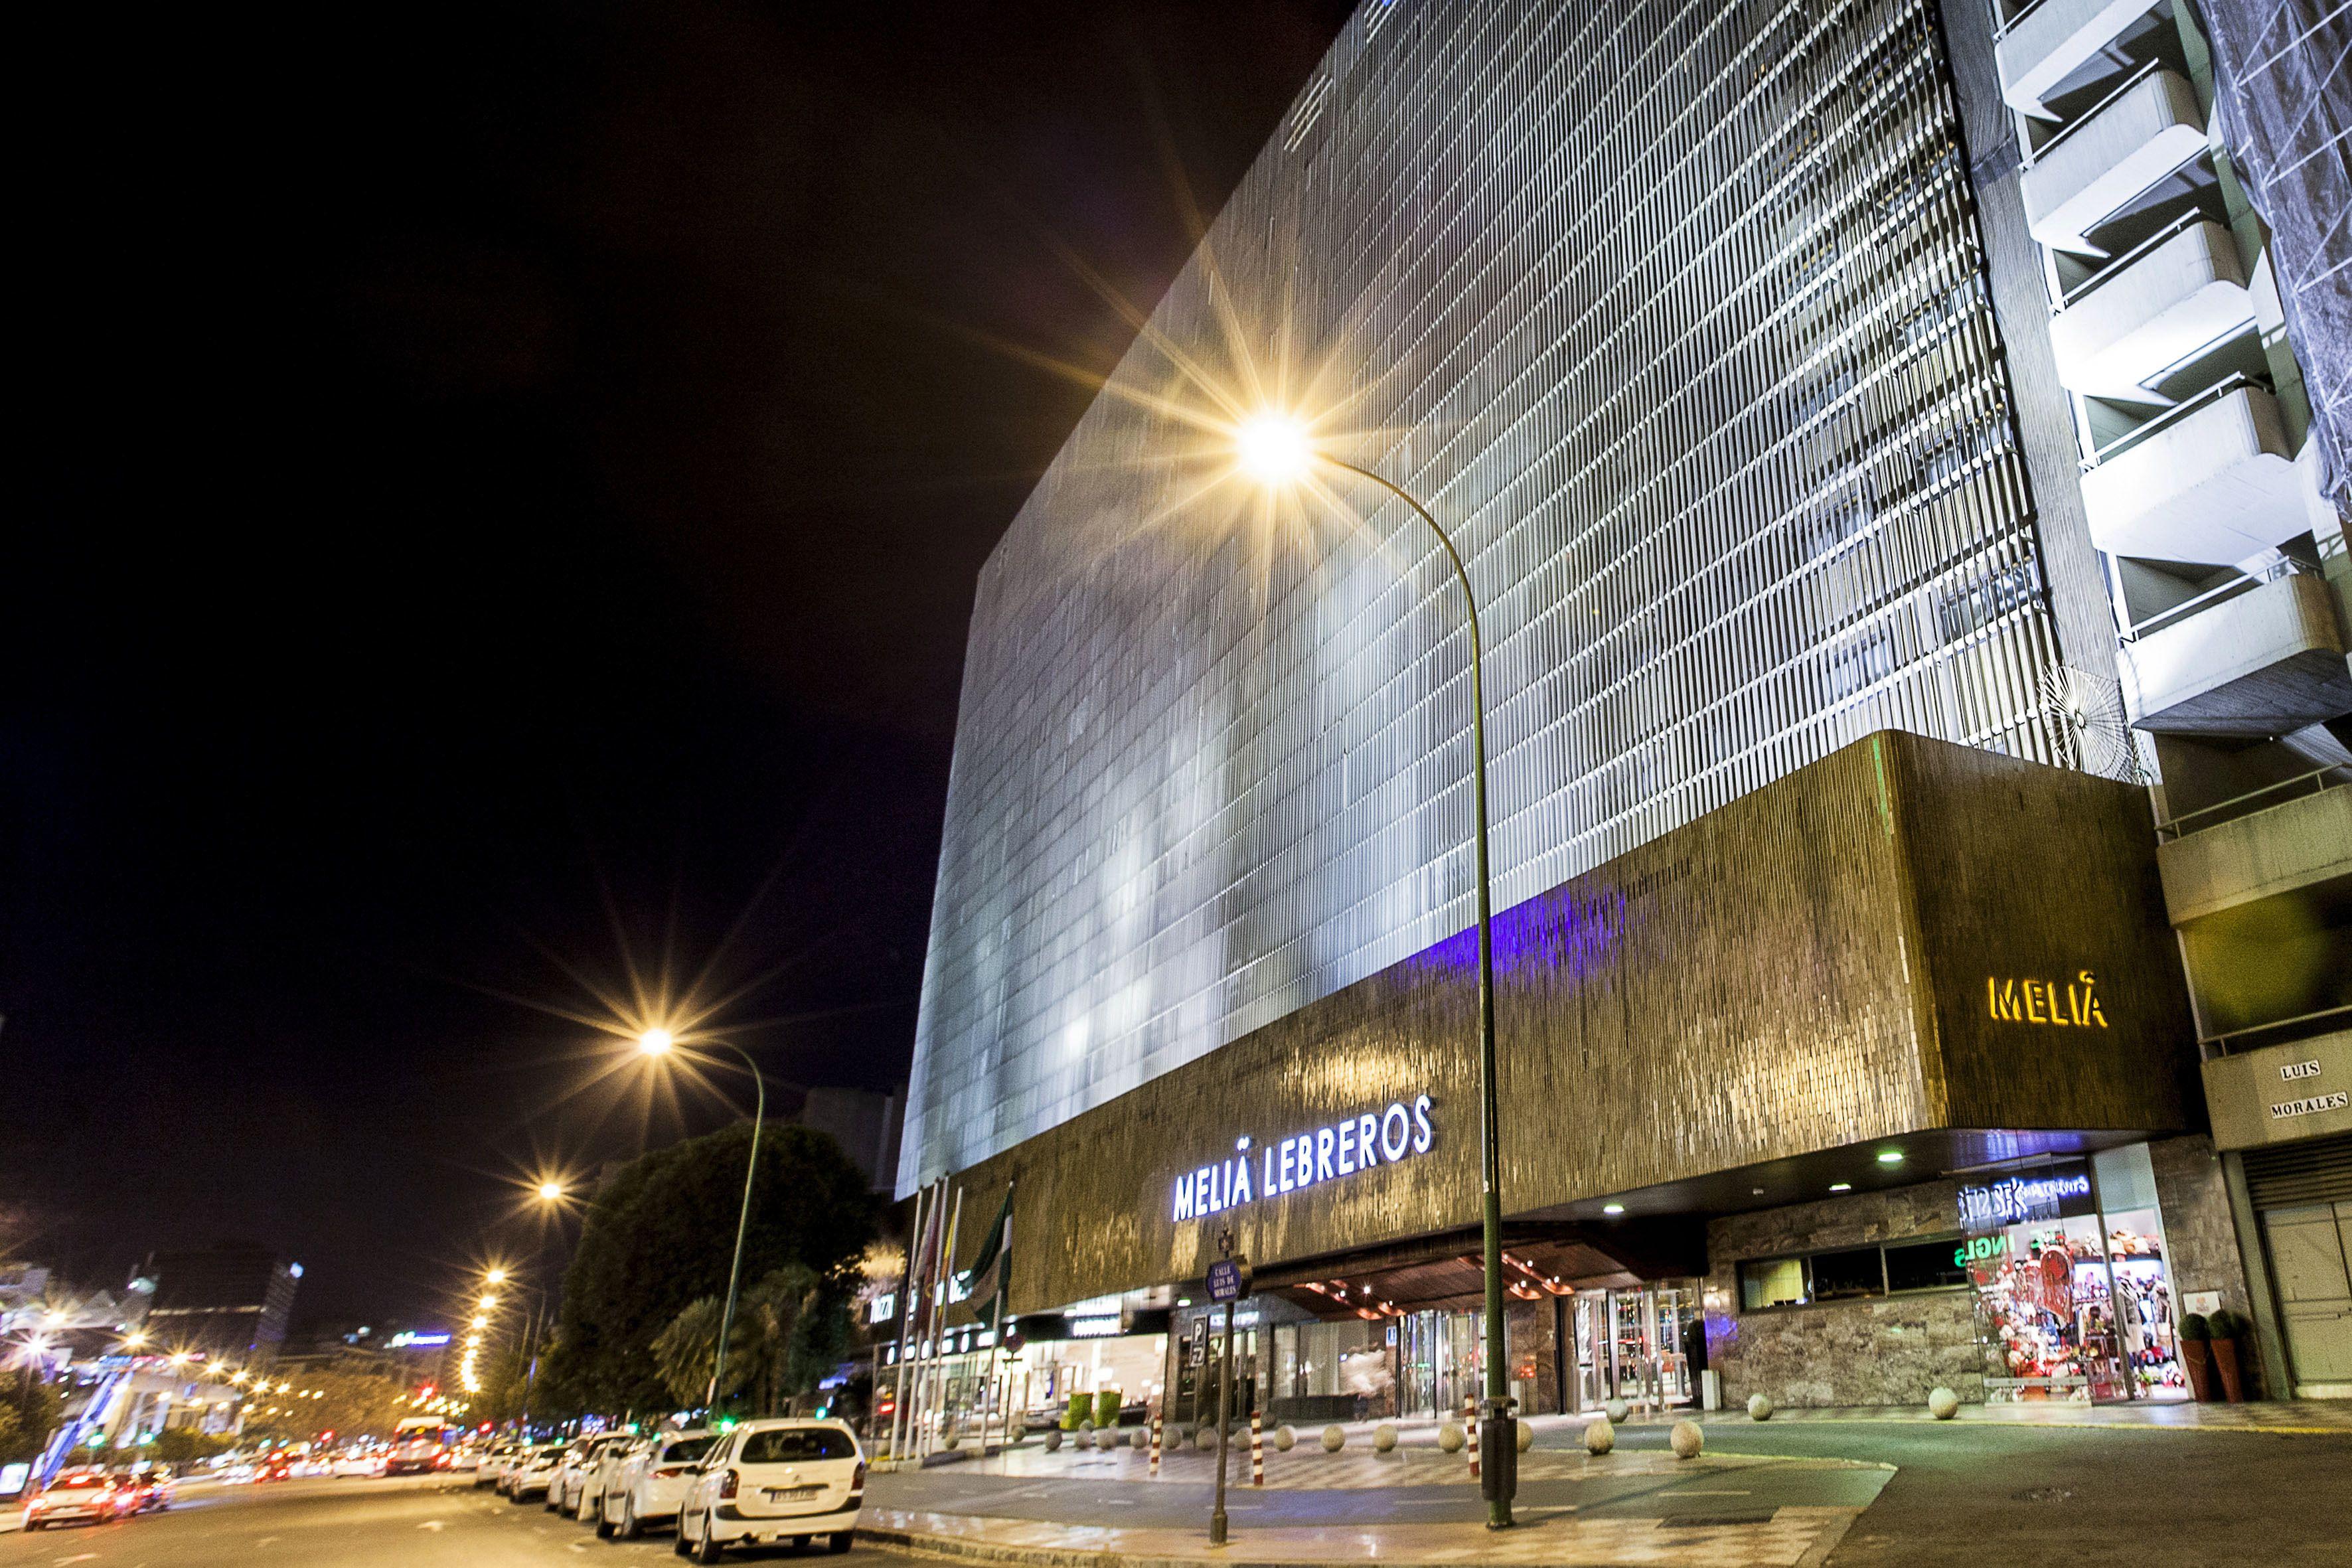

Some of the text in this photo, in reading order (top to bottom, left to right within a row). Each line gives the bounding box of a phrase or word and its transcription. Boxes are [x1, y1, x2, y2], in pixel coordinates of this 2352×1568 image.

[1988, 970, 2108, 1028] MELIÁ
[2282, 1062, 2319, 1079] LUIS
[2271, 1094, 2347, 1117] MORALES
[1172, 1094, 1433, 1222] MELIÁ LEBREROS
[1227, 1275, 1234, 1285] DE
[1194, 1323, 1203, 1342] P
